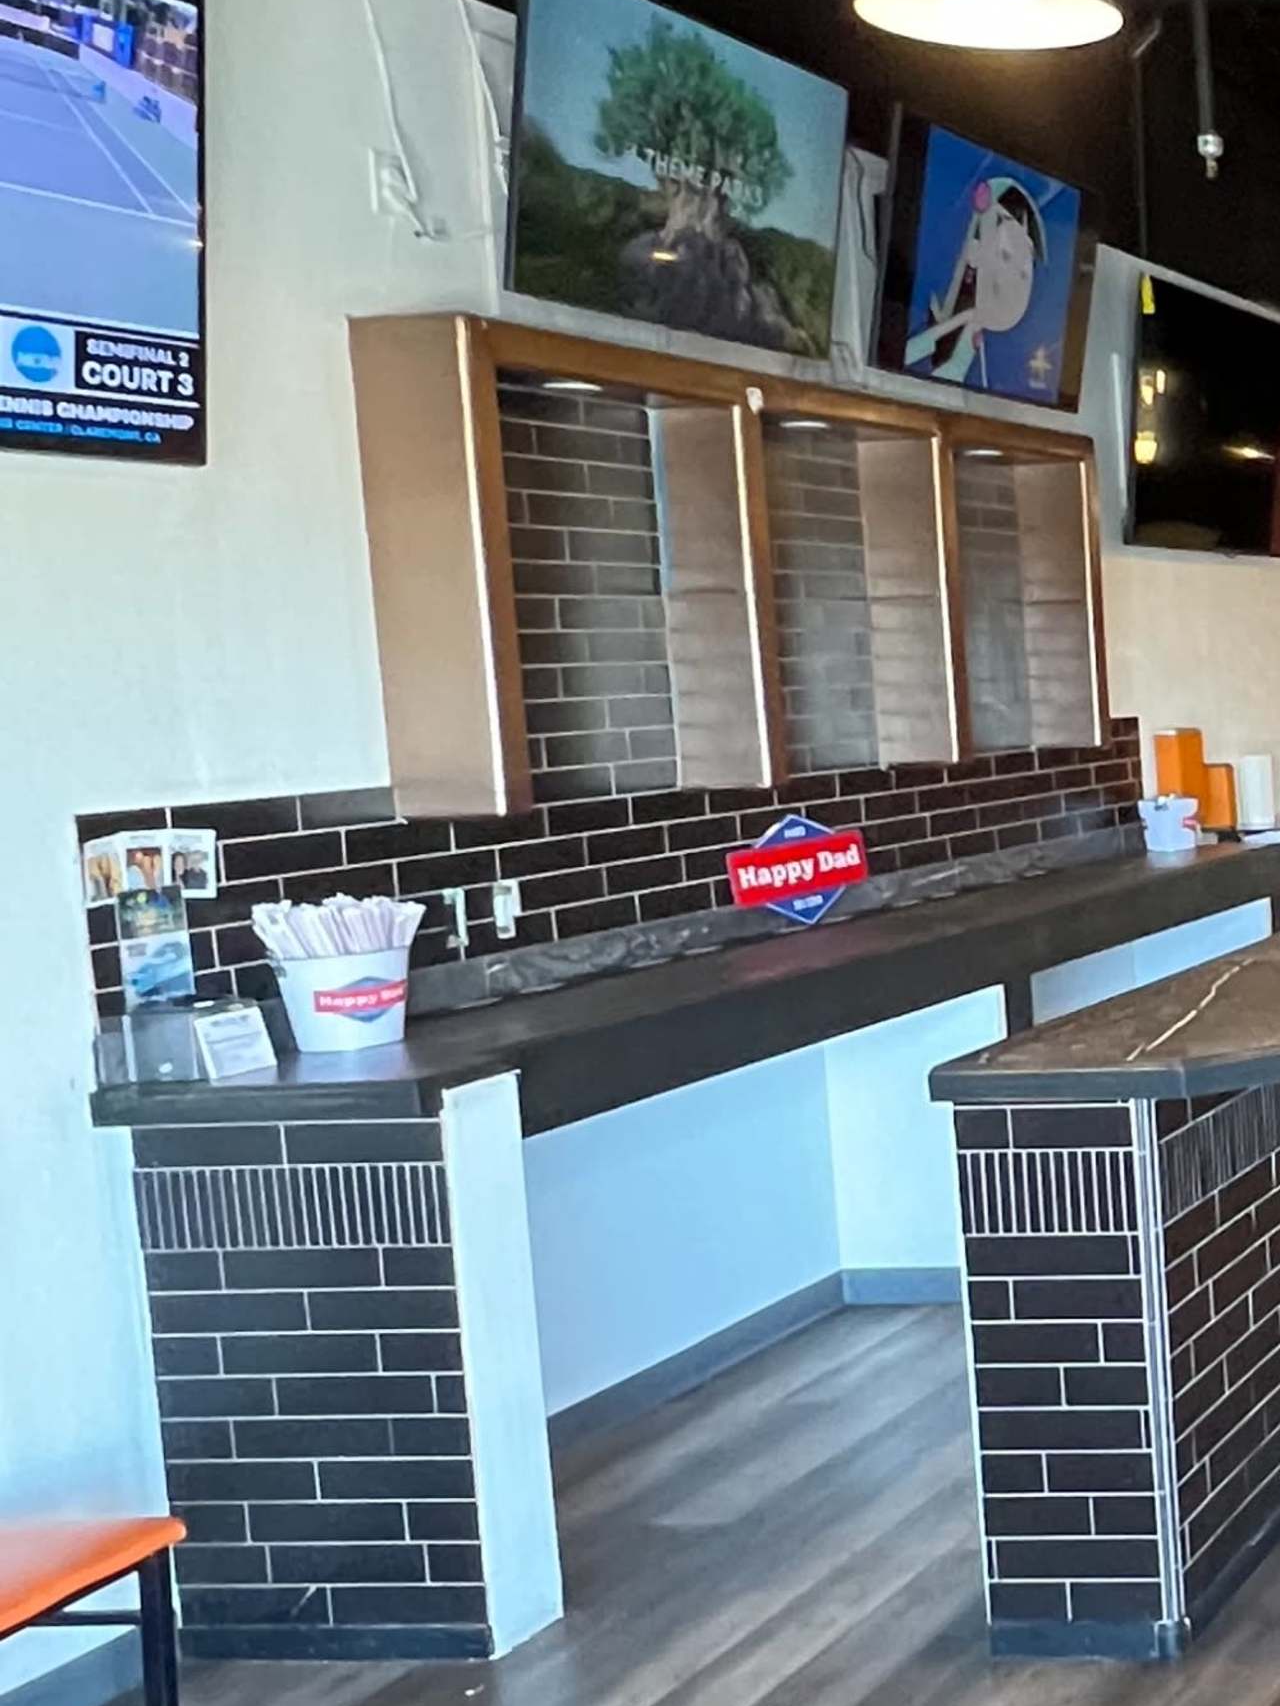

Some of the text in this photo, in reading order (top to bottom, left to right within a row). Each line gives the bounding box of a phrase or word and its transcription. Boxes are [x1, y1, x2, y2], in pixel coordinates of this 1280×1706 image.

[643, 147, 706, 187] THEME
[86, 338, 177, 366] SEMIFINAL
[82, 360, 195, 397] COURT 3
[0, 395, 195, 431] ENNIS CHAMPIONSHIP
[737, 843, 861, 890] Happy Dad
[319, 995, 378, 1007] Happy
